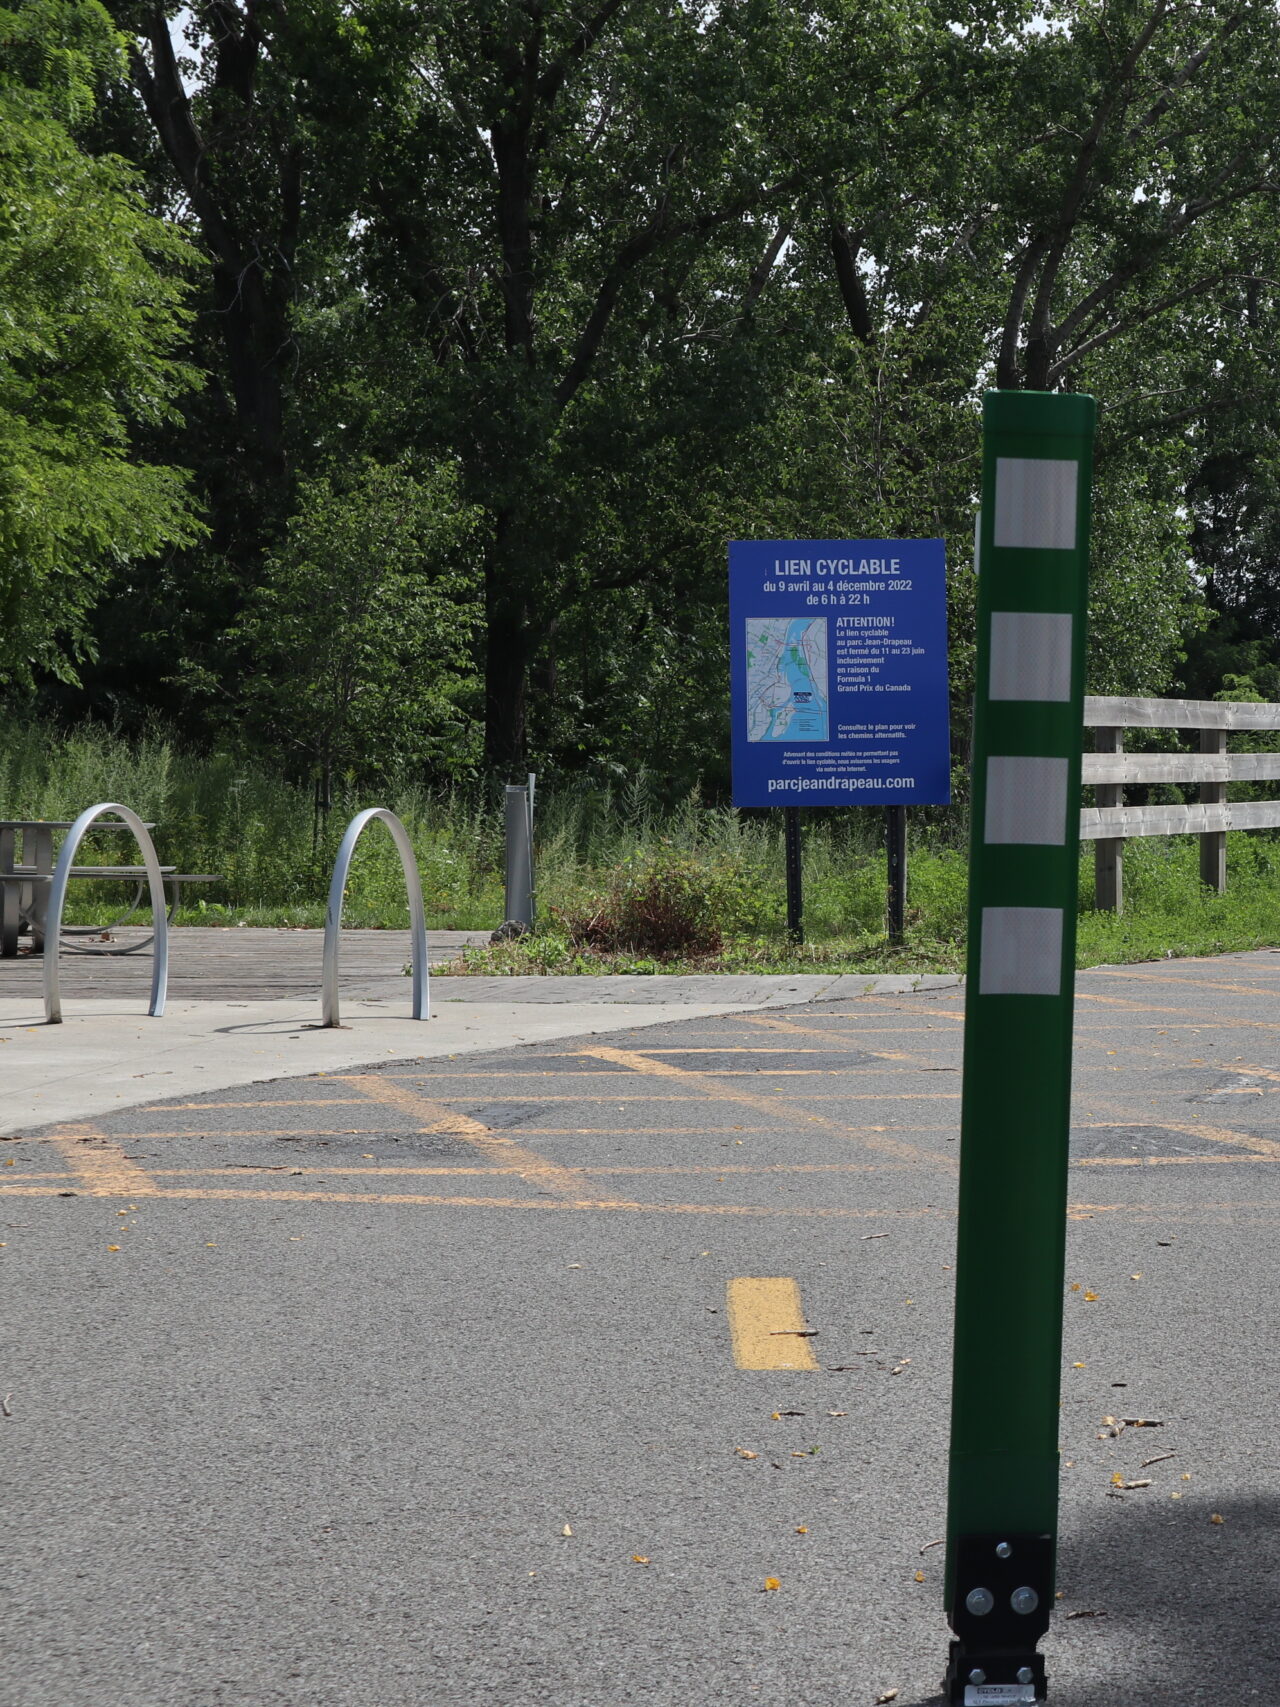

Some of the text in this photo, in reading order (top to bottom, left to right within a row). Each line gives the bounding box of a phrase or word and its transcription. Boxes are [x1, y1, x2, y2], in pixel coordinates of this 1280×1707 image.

[775, 559, 900, 575] LIEN CYCLABLE
[764, 580, 912, 592] du 9 avril au 4 décembre 2022
[806, 594, 870, 605] de 6 h à 22 h
[836, 617, 895, 627] ATTENTION!
[860, 629, 888, 637] cyclable
[847, 639, 862, 647] parc
[864, 638, 912, 646] Jean-Drapeau
[912, 647, 925, 655] juin
[768, 776, 915, 792] parcjeandrapeau.com
